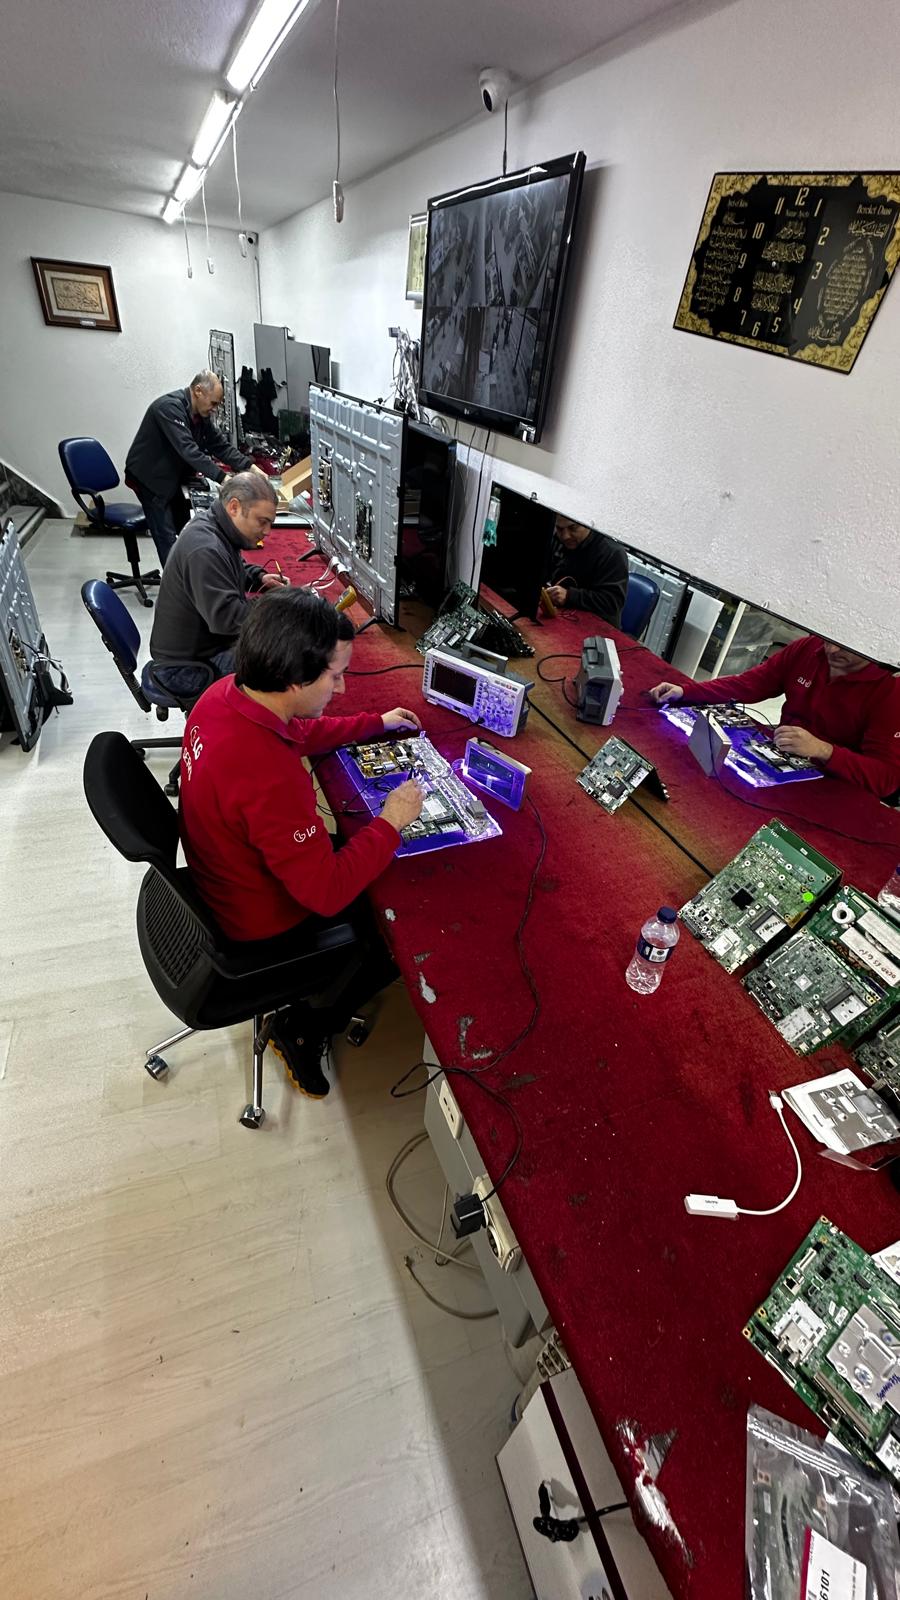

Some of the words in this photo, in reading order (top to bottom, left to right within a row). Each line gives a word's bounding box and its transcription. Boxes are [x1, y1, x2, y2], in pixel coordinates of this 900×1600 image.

[795, 187, 809, 206] 12
[774, 197, 784, 215] 11
[814, 199, 822, 217] 1
[752, 222, 765, 239] 10
[818, 227, 829, 246] 2
[738, 253, 747, 269] 9
[811, 262, 822, 280] 3
[733, 287, 742, 302] 8
[793, 298, 802, 314] 4
[740, 310, 747, 325] 7
[771, 317, 781, 333] 5
[752, 322, 761, 336] 6
[193, 736, 203, 760] LG
[819, 1568, 830, 1600] 6101
